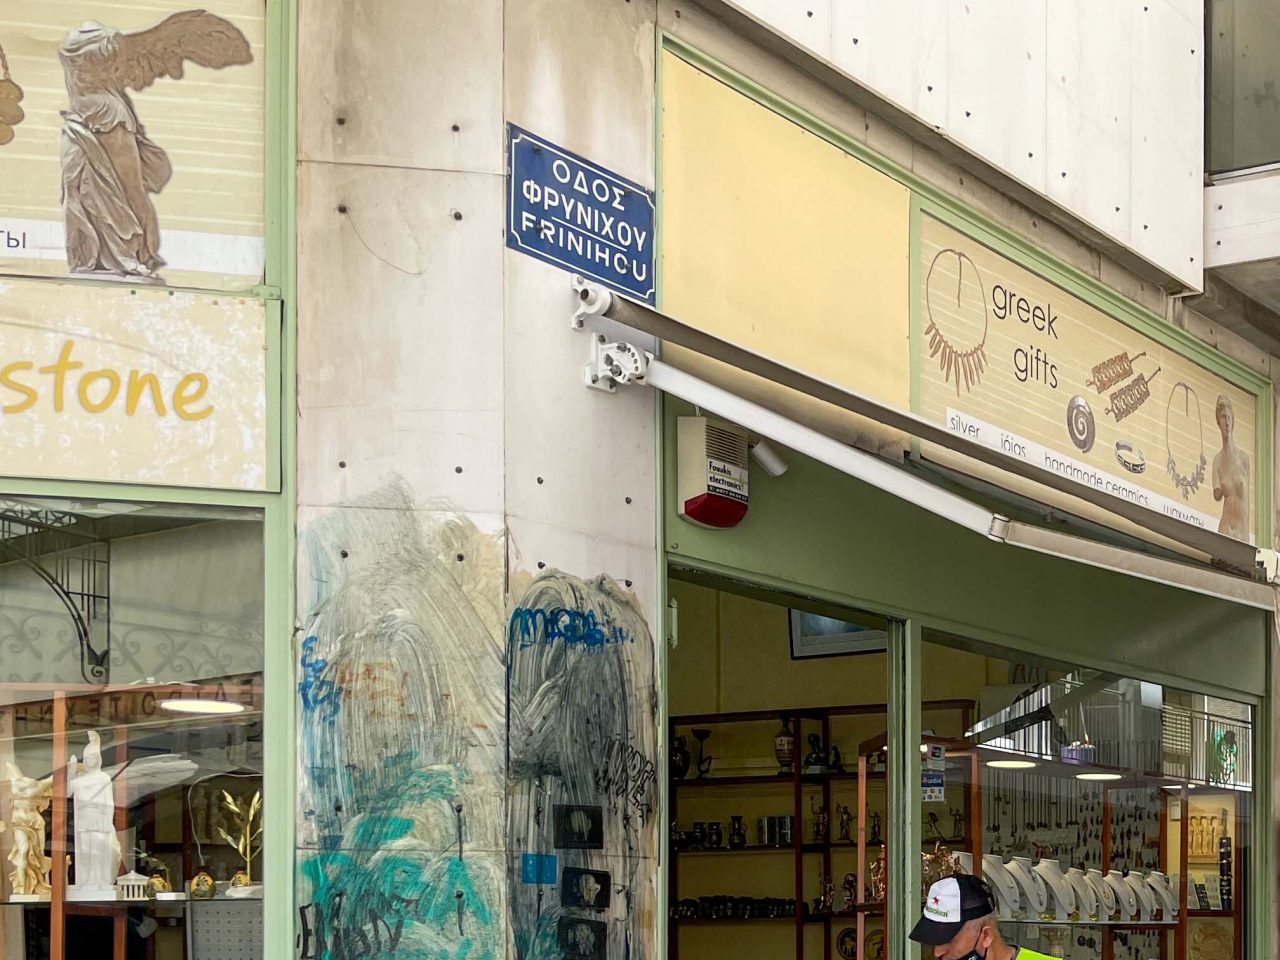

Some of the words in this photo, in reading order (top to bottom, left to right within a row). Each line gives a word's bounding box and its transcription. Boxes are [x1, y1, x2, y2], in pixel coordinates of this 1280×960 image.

[552, 159, 625, 212] ΟΔΟΣ
[522, 179, 647, 252] ΦΡΥΝΙΧΟΥ
[521, 211, 647, 282] FRINIHOU
[992, 284, 1058, 340] greek
[0, 339, 215, 421] stone
[1013, 345, 1058, 389] gifts
[950, 414, 980, 439] silver
[709, 475, 742, 491] electronics
[1044, 452, 1103, 487] handmade
[1105, 480, 1149, 507] ceramics
